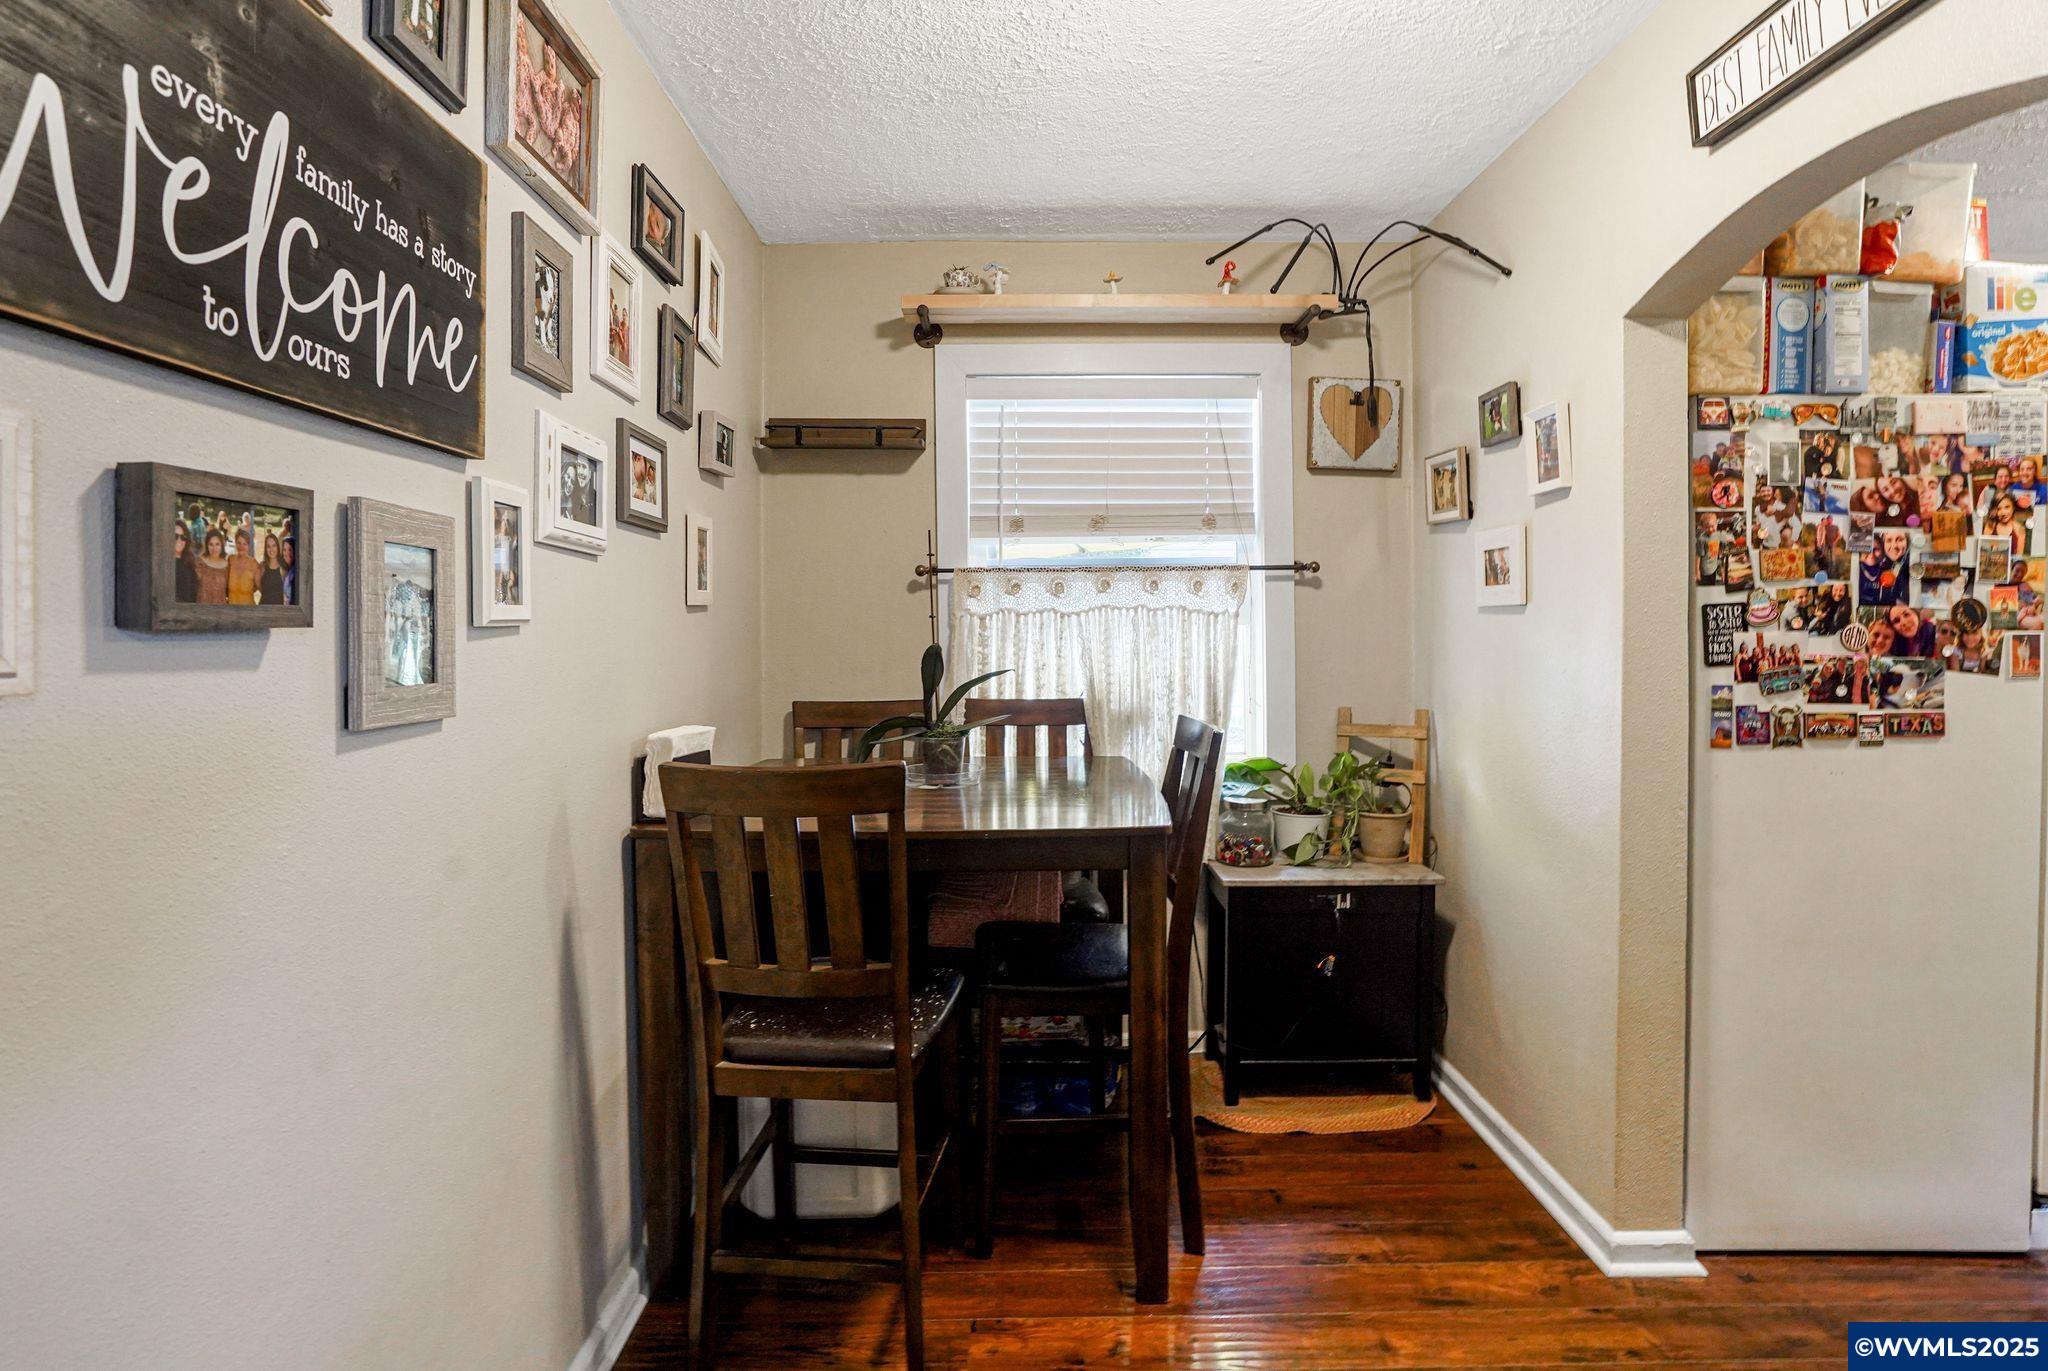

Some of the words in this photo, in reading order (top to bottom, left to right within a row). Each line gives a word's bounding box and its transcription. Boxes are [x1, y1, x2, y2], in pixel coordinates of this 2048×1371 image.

[1701, 47, 1744, 131] BEST
[1756, 0, 1824, 91] FAMILY
[150, 64, 258, 161] every
[295, 146, 369, 232] family
[375, 200, 408, 248] has
[414, 234, 424, 259] a
[431, 243, 477, 298] story
[203, 285, 239, 337] to
[287, 335, 351, 379] ours
[1972, 324, 2006, 339] original
[1890, 714, 1943, 734] TEXAS
